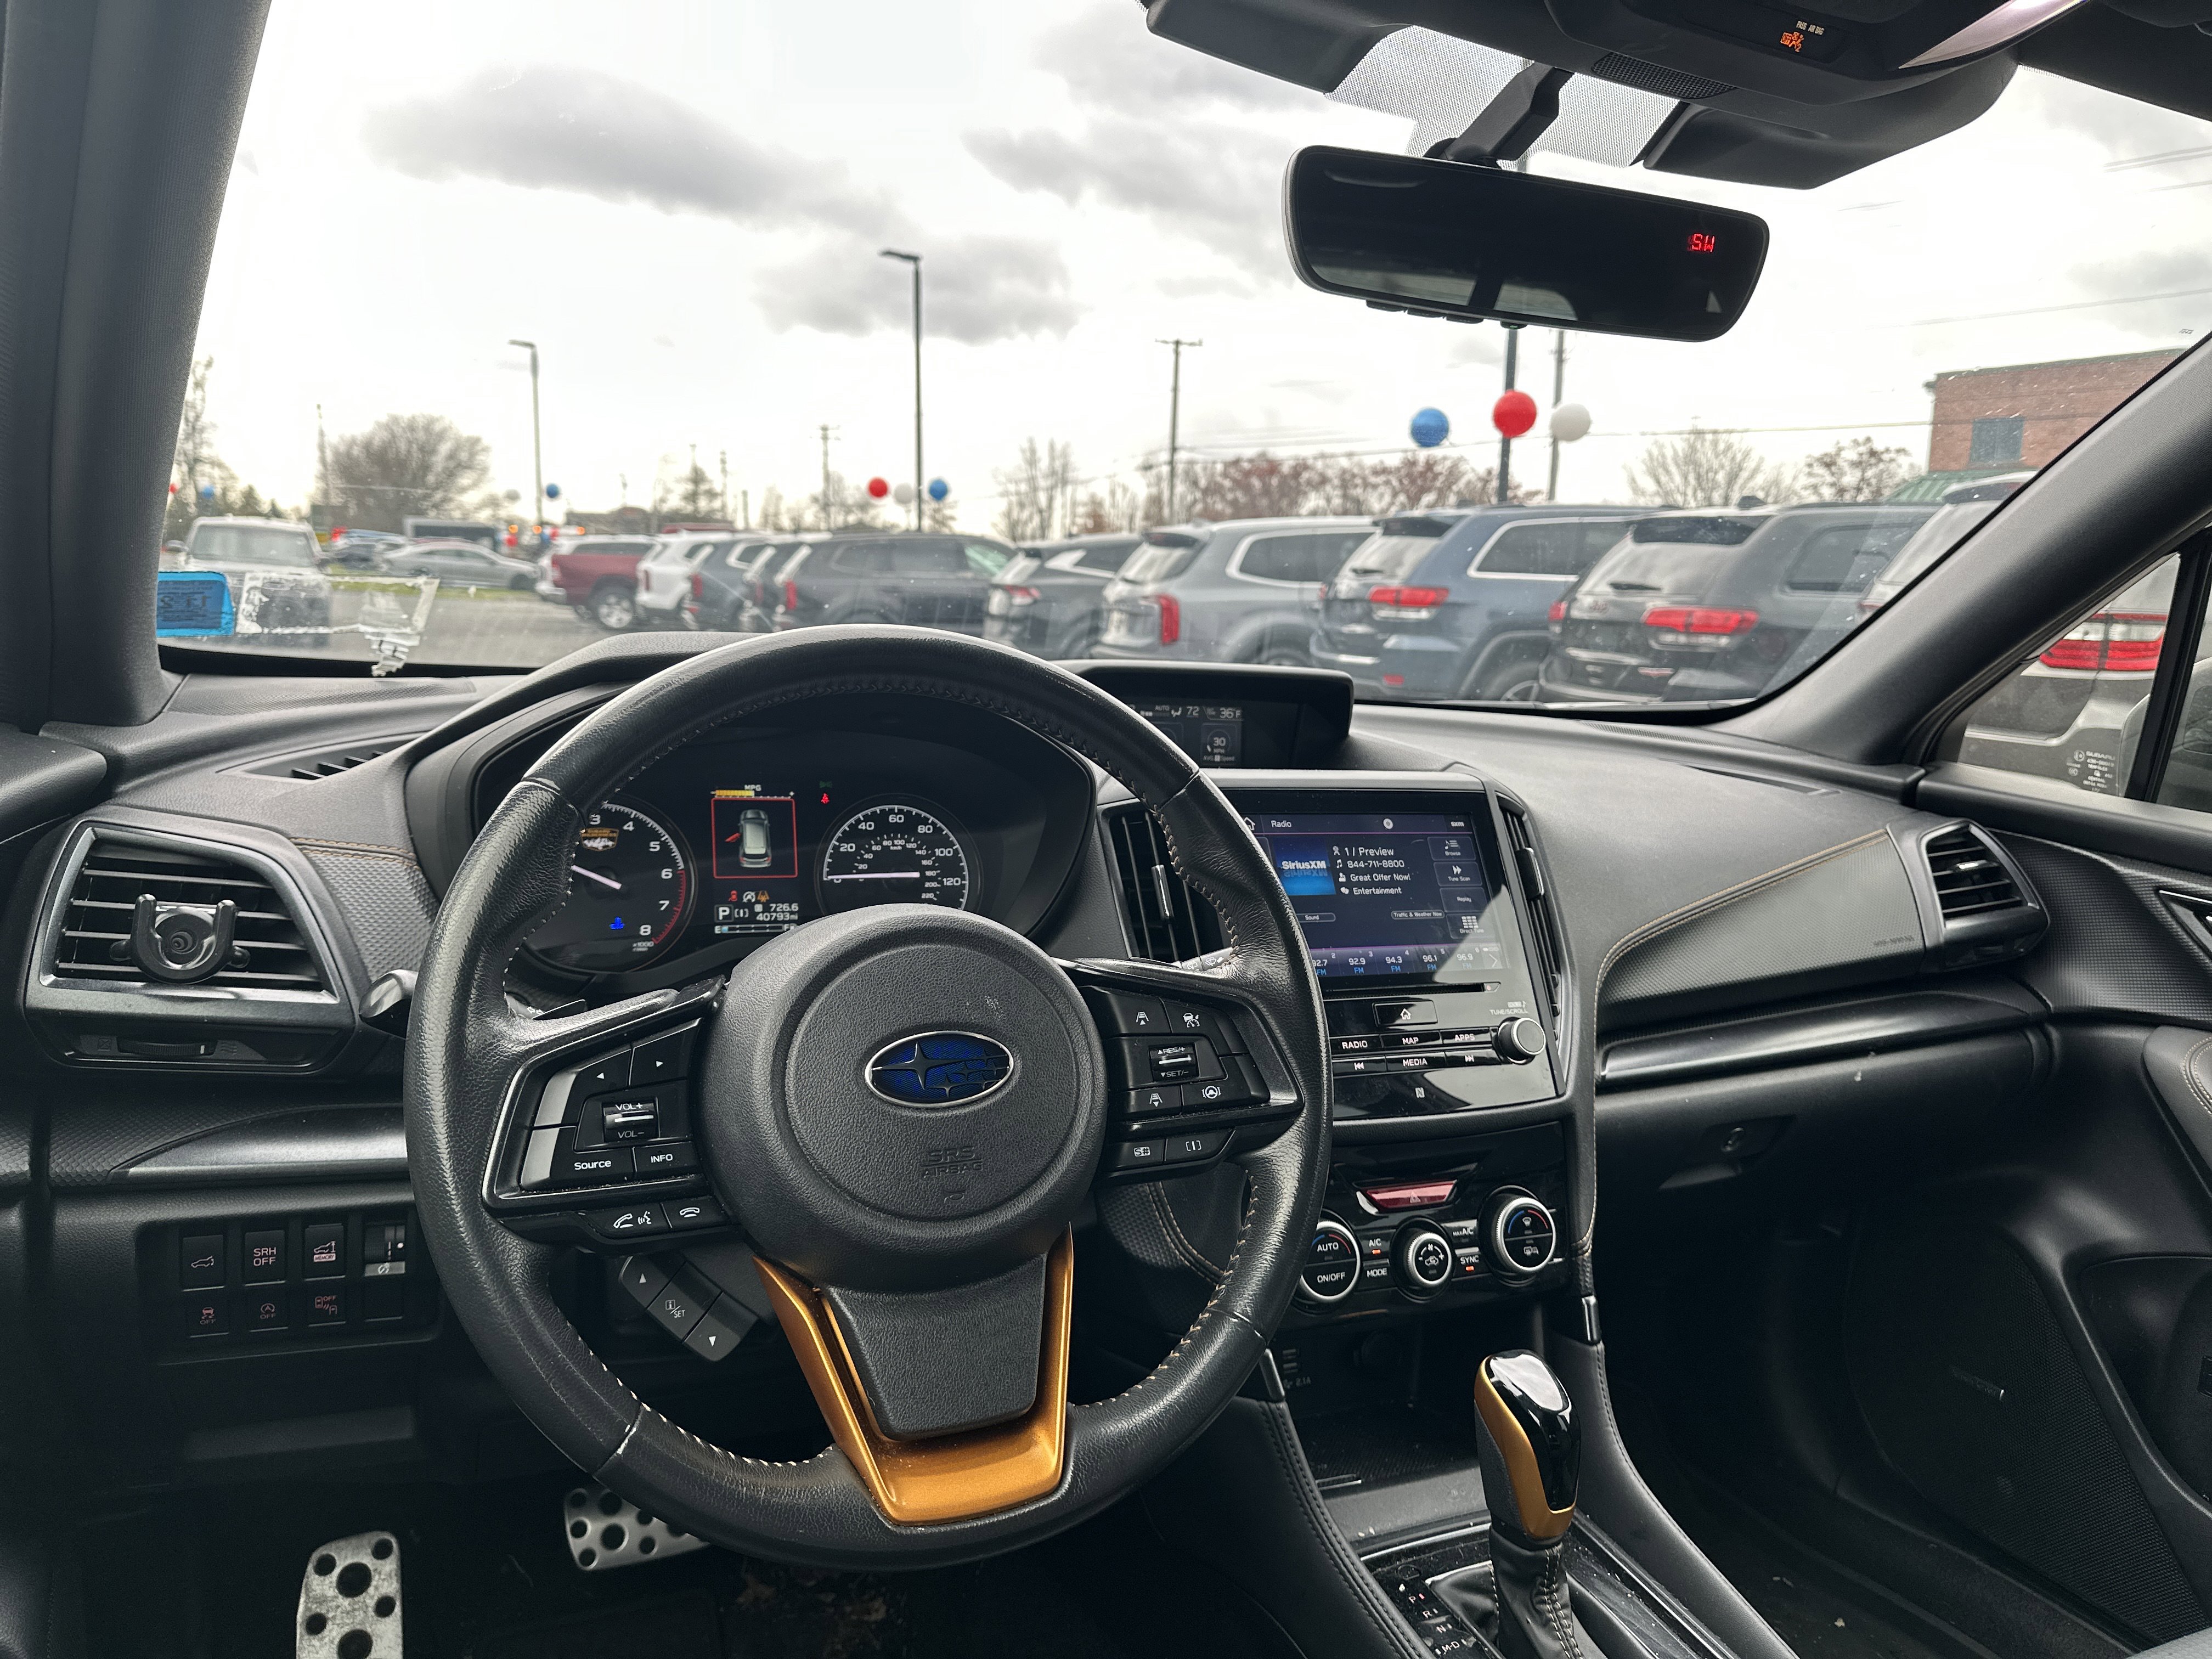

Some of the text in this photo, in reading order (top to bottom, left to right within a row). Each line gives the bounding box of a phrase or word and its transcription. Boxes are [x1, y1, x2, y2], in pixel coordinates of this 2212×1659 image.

[1691, 233, 1716, 252] SW
[1187, 706, 1199, 716] 72
[1214, 737, 1226, 746] 30
[590, 814, 601, 825] 3
[888, 814, 905, 823] 60
[623, 821, 635, 831] 4
[857, 821, 875, 831] 40
[1271, 820, 1293, 828] Radio
[917, 825, 933, 833] 80
[649, 841, 661, 851] 5
[839, 843, 856, 852] 20
[934, 848, 953, 856] 100
[1358, 846, 1394, 856] Preview
[1282, 860, 1327, 870] SiriusXM
[1347, 860, 1405, 868] 844-711-8800
[661, 868, 673, 879] 6
[1350, 873, 1370, 882] Great
[1372, 873, 1391, 881] Offer
[942, 877, 961, 886] 120
[1353, 886, 1402, 895] Entertainment
[658, 900, 670, 911] 7
[769, 903, 799, 912] 726.6
[718, 906, 730, 921] P
[639, 924, 651, 936] 8
[714, 926, 721, 934] E
[1348, 957, 1366, 966] 92.9
[1385, 956, 1403, 964] 94.3
[1457, 953, 1474, 961] 96.9
[1342, 1040, 1368, 1049] RADIO
[1402, 1058, 1427, 1066] MEDIA
[650, 1154, 673, 1163] INFO
[928, 1146, 976, 1164] SRS
[574, 1159, 611, 1170] Source
[923, 1161, 984, 1179] AIRBAG
[1462, 1227, 1474, 1235] A/C
[1369, 1238, 1381, 1246] A/C
[1317, 1242, 1339, 1252] AUTO
[253, 1248, 276, 1257] SRH
[253, 1257, 276, 1266] OFF
[1460, 1255, 1480, 1265] SYNC
[1317, 1272, 1346, 1283] ON/OFF
[1367, 1268, 1387, 1278] MODE
[1409, 1595, 1416, 1604] P
[1422, 1610, 1433, 1618] R
[1436, 1625, 1447, 1633] N
